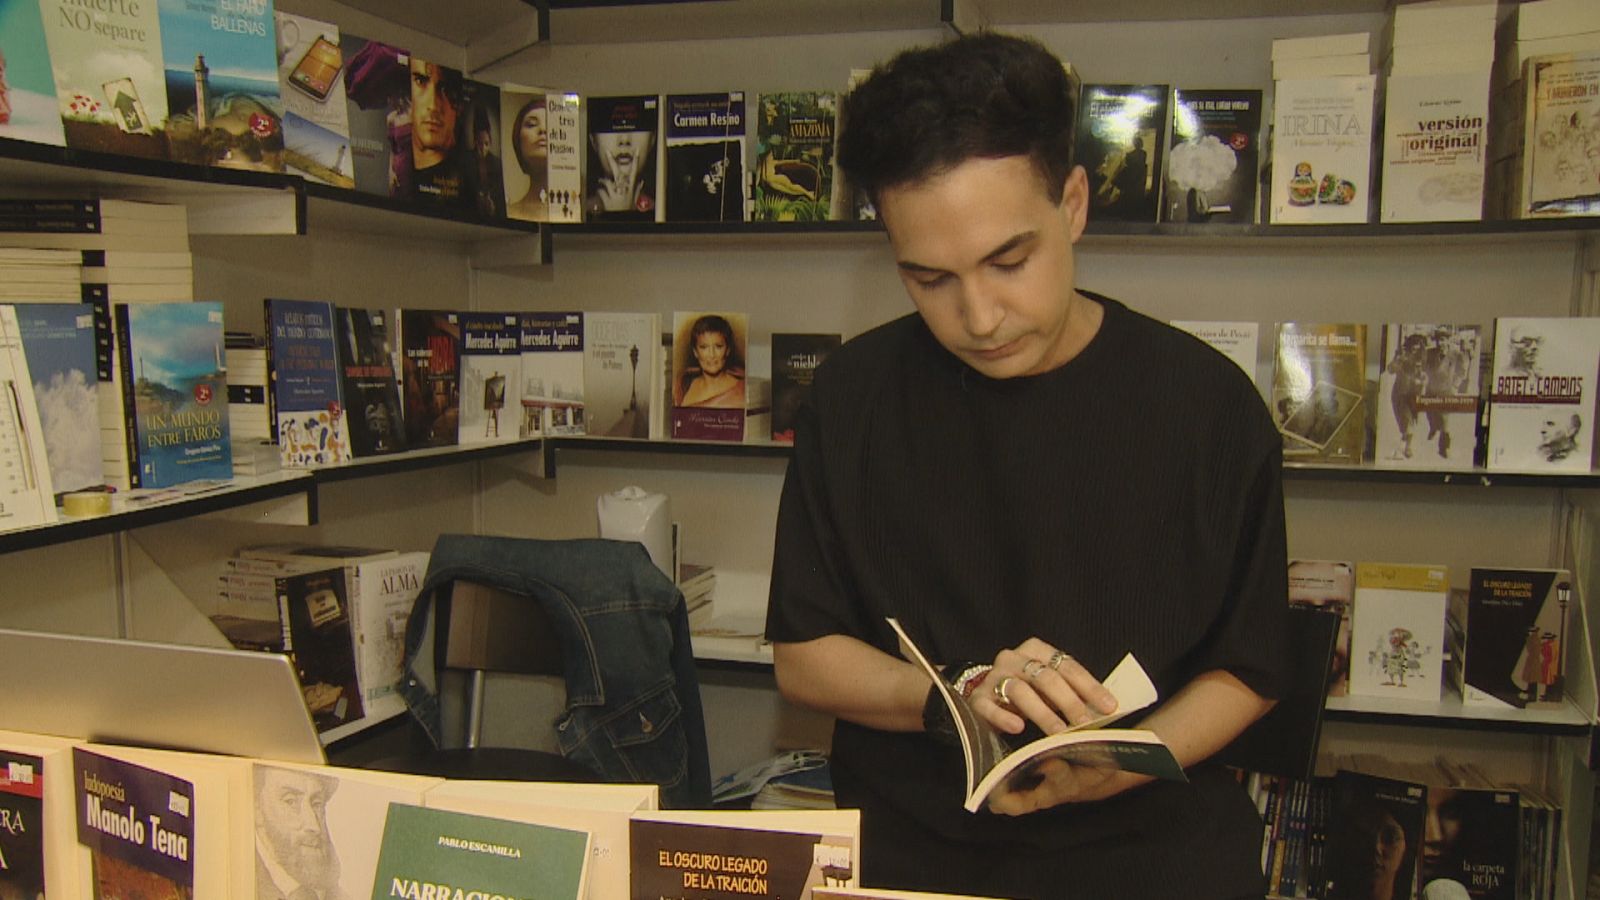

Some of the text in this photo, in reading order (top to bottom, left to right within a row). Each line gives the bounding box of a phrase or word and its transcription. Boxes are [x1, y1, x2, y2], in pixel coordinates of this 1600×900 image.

[59, 6, 147, 42] NO separe
[210, 14, 267, 37] BALLENAS
[674, 112, 708, 127] Carmen
[1281, 114, 1363, 136] IRINA
[1418, 115, 1482, 131] versión
[1410, 133, 1478, 152] original
[466, 332, 517, 353] Mercedes Aguirre
[552, 329, 579, 350] Aguirre
[1498, 376, 1528, 396] BATET
[1537, 376, 1583, 396] CAMPINS
[147, 408, 220, 431] UN MUNDO
[148, 426, 222, 448] ENTRE FAROS
[379, 573, 419, 596] ALMA
[0, 808, 26, 836] RA
[87, 793, 188, 861] Manolo Tena
[438, 835, 522, 859] PABLO ESCAMILLA
[659, 850, 768, 875] EL OSCURO LEGADO
[1463, 859, 1505, 880] la carpeta
[684, 871, 768, 895] DE LA TRAICIÓN
[1472, 873, 1500, 889] ROJA
